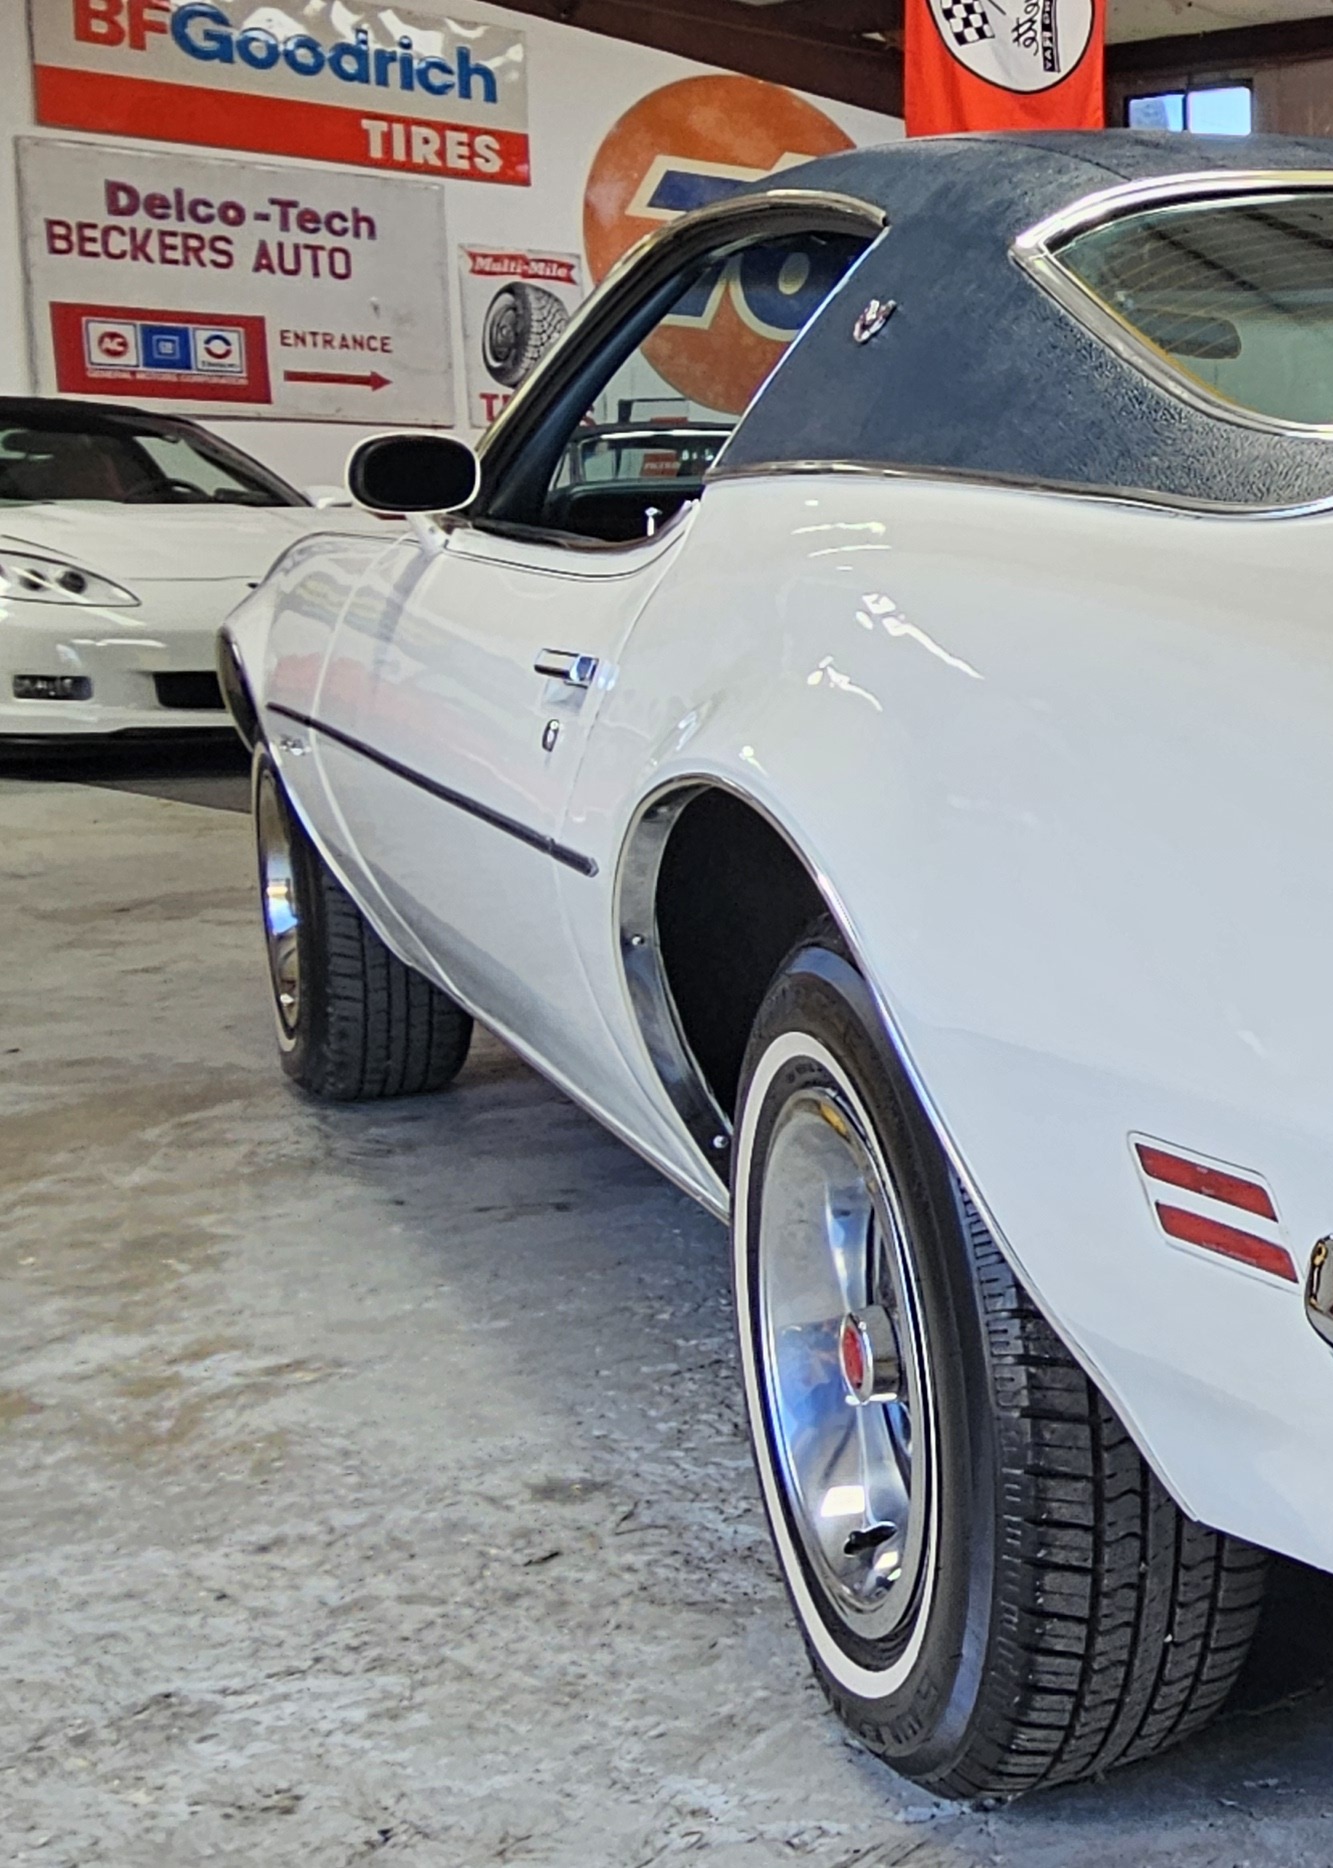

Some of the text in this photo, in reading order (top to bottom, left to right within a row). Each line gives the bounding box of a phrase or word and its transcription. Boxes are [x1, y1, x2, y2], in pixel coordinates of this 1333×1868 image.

[72, 0, 498, 102] BFGoodrich
[361, 118, 503, 174] TIRES
[105, 179, 378, 241] Delco-Tech
[45, 217, 352, 280] BECKERS AUTO
[474, 256, 569, 278] Multi-Mile
[280, 329, 394, 353] ENTRANCE
